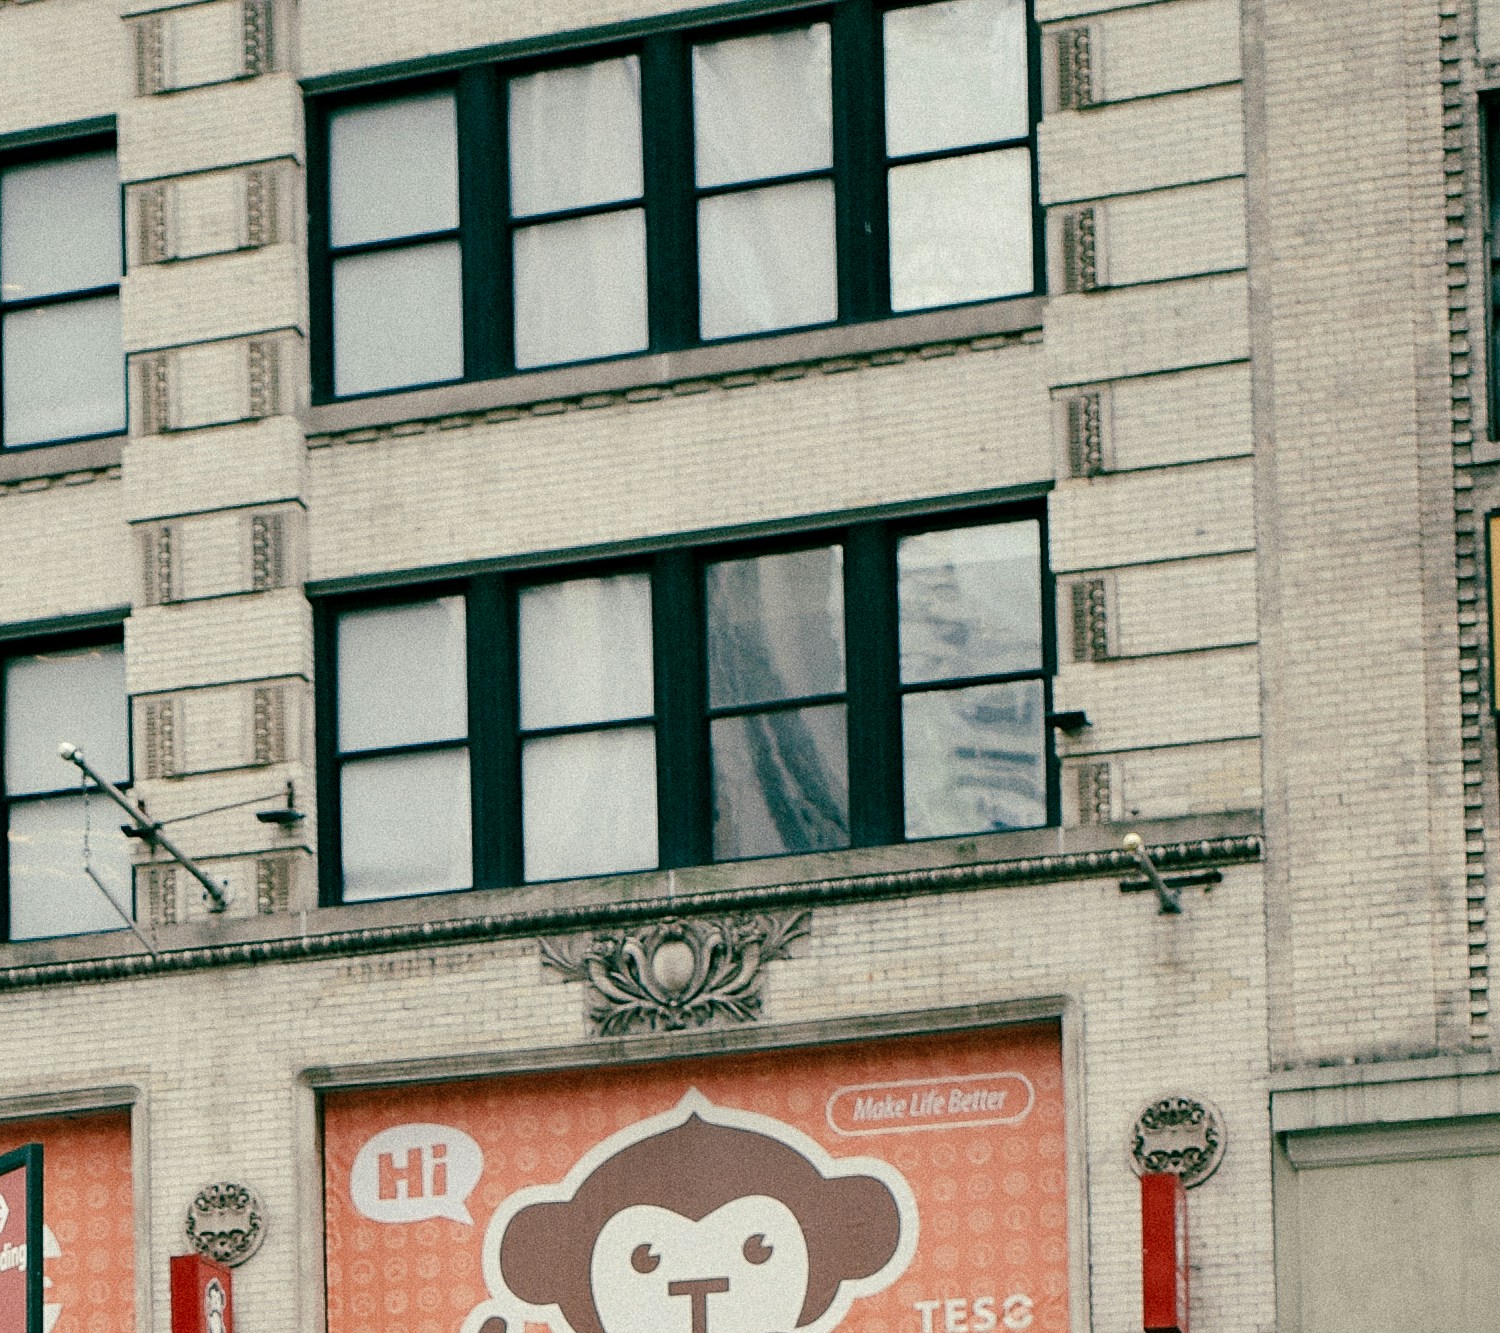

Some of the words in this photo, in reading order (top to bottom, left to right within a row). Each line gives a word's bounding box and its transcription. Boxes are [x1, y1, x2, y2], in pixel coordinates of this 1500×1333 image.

[853, 1093, 906, 1122] Make
[910, 1090, 945, 1117] Life
[949, 1088, 1007, 1113] Better
[378, 1149, 449, 1202] Hi
